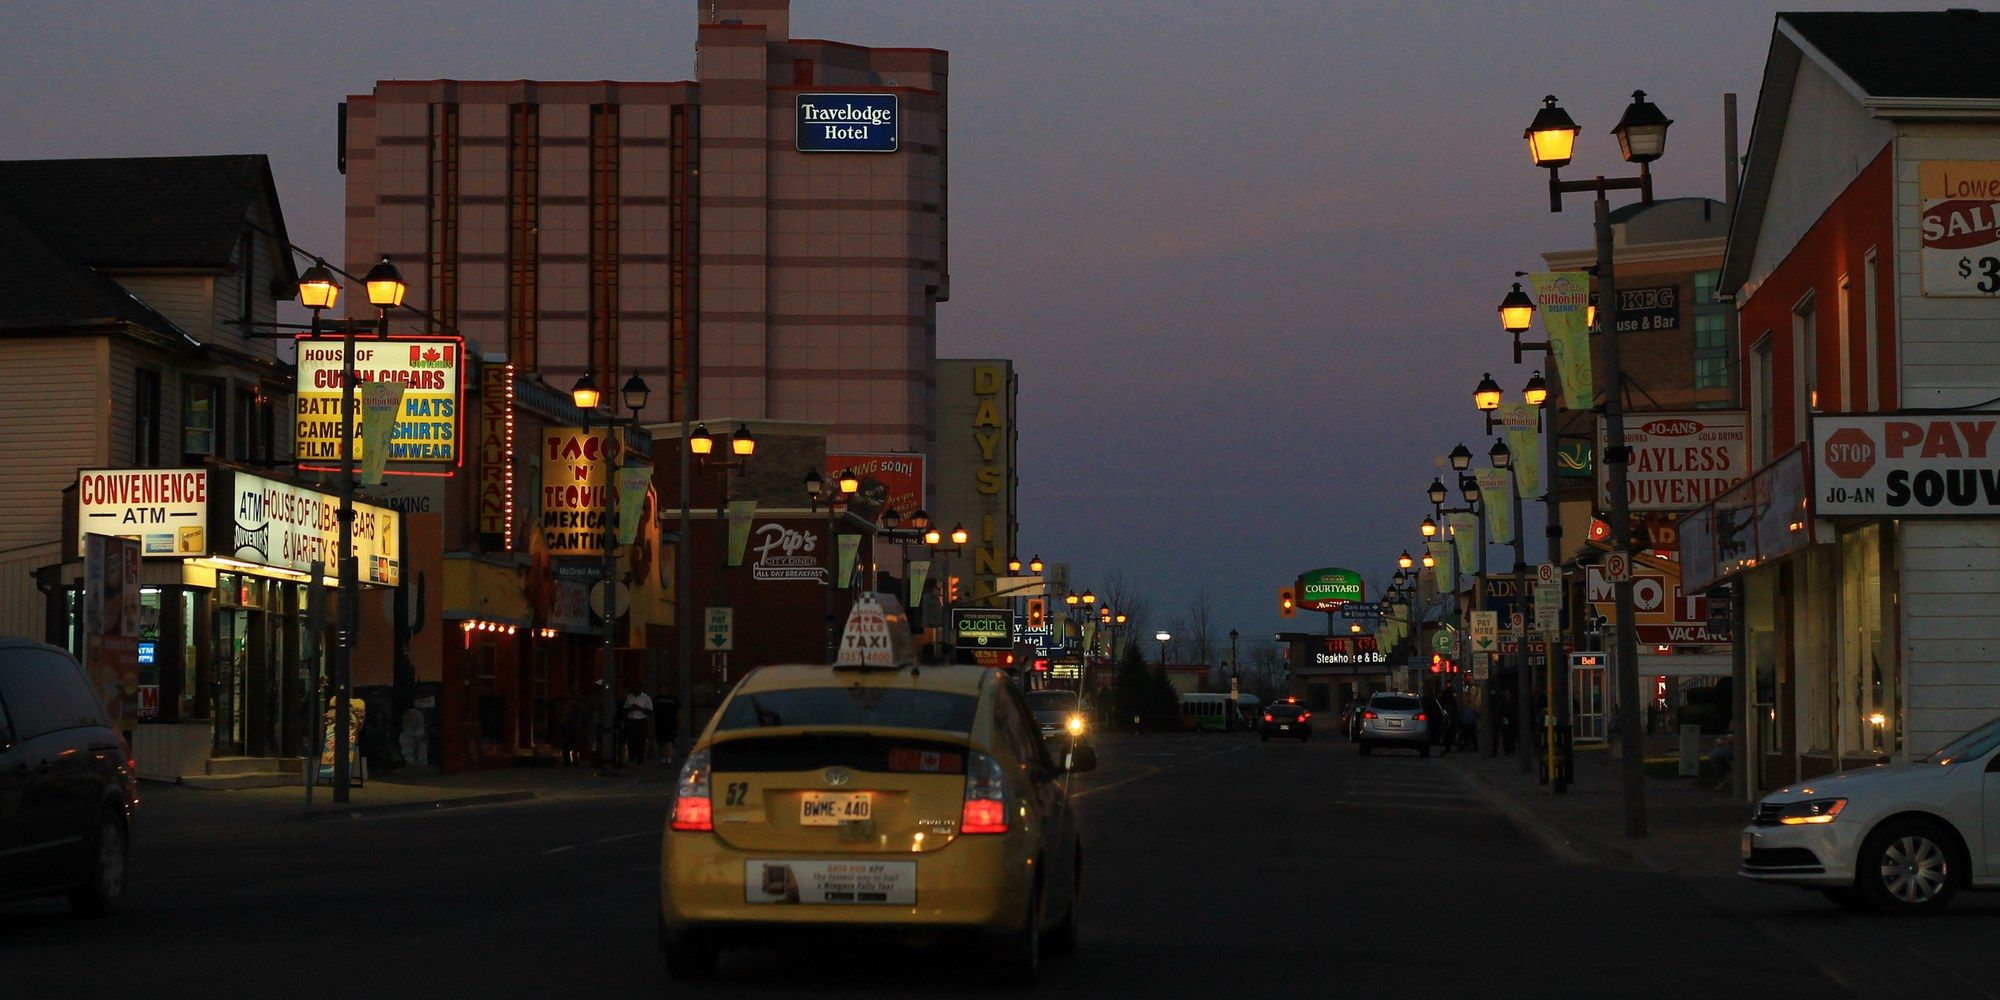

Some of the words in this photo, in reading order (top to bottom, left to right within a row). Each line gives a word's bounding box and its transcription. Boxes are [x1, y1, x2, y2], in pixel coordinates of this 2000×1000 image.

[800, 103, 891, 126] Travelodge
[825, 125, 868, 140] Hotel
[1538, 293, 1571, 305] Clifton
[1571, 293, 1587, 304] Hill
[1653, 315, 1675, 329] Bar
[305, 349, 345, 361] HOUS
[356, 350, 375, 361] OF
[406, 398, 454, 417] HATS
[974, 365, 1002, 495] DAYS
[1648, 422, 1698, 435] JO-ANS
[1698, 433, 1717, 441] COLD
[1718, 431, 1744, 441] DRINKS
[1884, 421, 1997, 459] PAY
[297, 442, 335, 458] FILM
[483, 366, 504, 532] RESTAURANT
[547, 436, 621, 461] TACO
[1830, 443, 1872, 463] STOP
[82, 472, 206, 506] CONVENIENCE
[1826, 487, 1876, 503] JO-AN
[122, 507, 165, 524] ATM
[240, 491, 263, 523] ATM
[263, 488, 295, 524] HOUSE
[297, 497, 310, 528] OF
[753, 522, 818, 566] Pip's
[789, 557, 817, 565] DINER
[756, 570, 770, 578] ALL
[770, 570, 785, 578] DAY
[1305, 585, 1360, 594] COURTYARD
[712, 616, 726, 624] PAY
[959, 617, 1008, 631] cucina
[1477, 619, 1491, 627] PAY
[1474, 627, 1494, 635] HERE
[846, 636, 888, 649] TAXI
[1582, 656, 1597, 665] Bell
[726, 782, 748, 806] 52
[803, 801, 836, 817] BWME
[844, 800, 869, 816] 440
